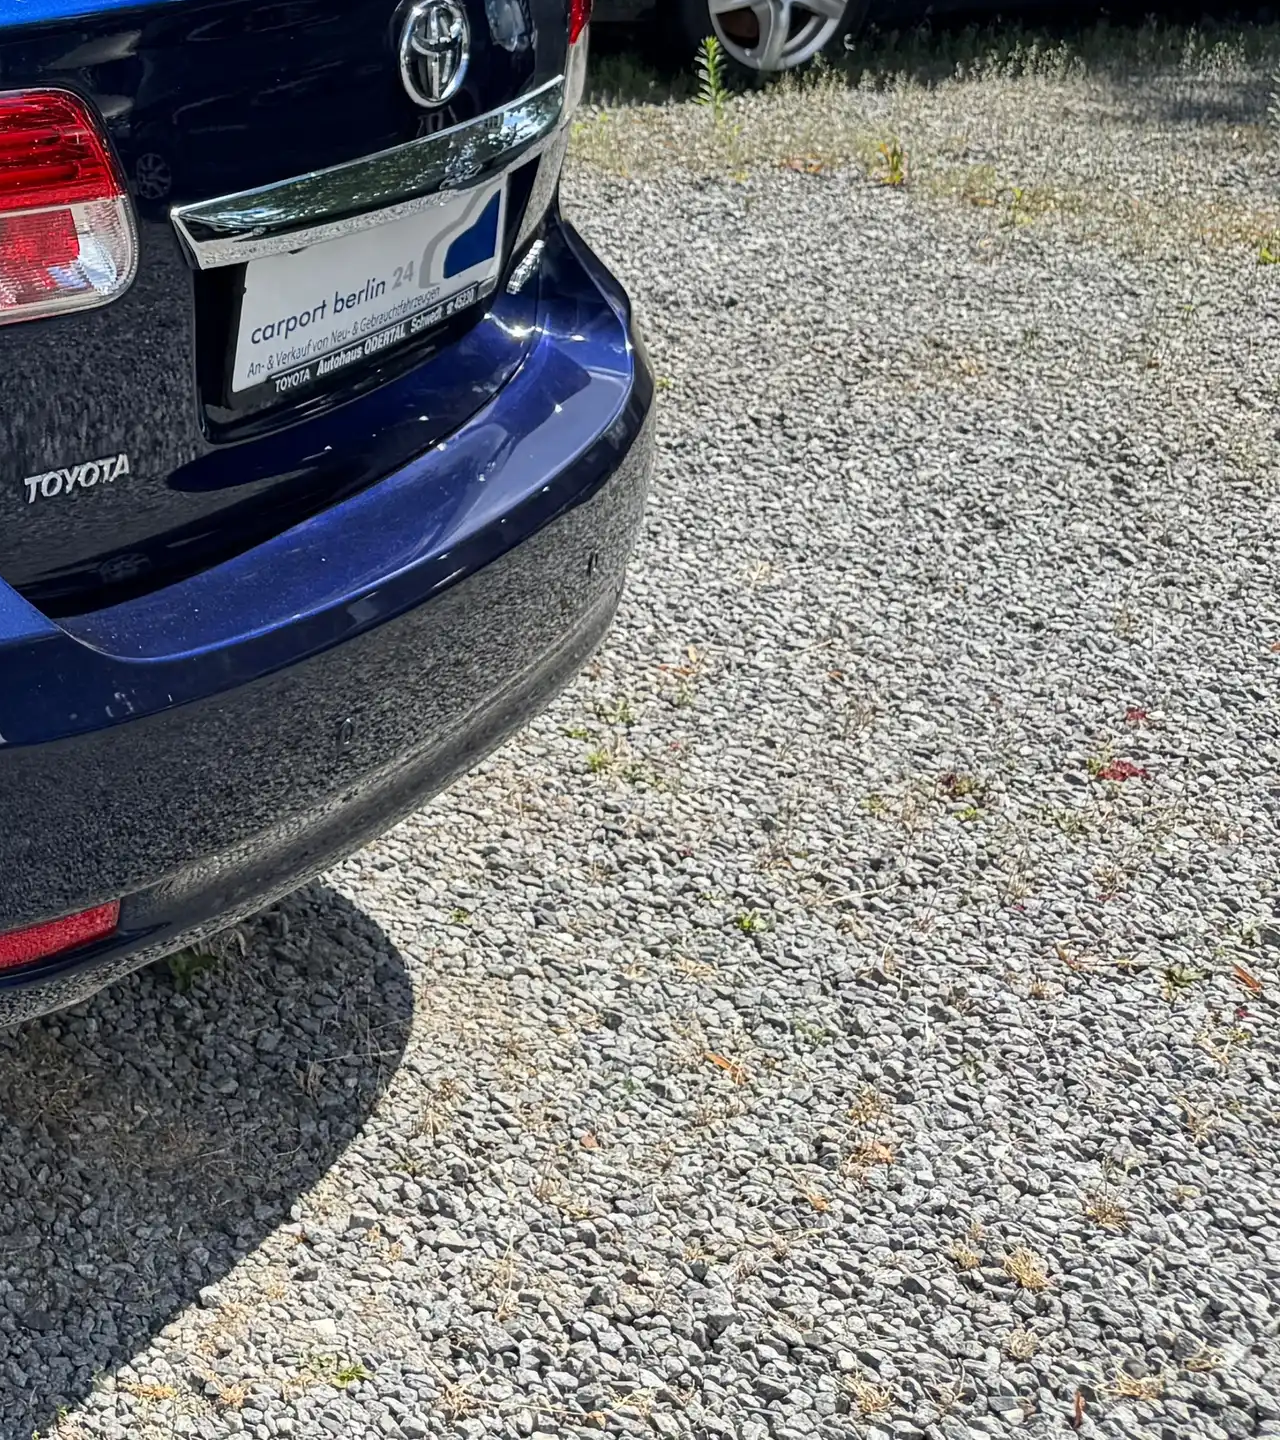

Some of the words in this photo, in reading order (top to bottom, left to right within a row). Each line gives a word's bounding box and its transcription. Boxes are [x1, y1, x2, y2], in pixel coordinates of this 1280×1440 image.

[250, 299, 328, 345] carport
[333, 277, 387, 316] berlin
[391, 260, 415, 291] 24
[246, 361, 266, 379] An-
[266, 354, 275, 371] &
[275, 339, 313, 368] Verkauf
[312, 336, 329, 352] von
[330, 329, 351, 346] Neu-
[351, 320, 359, 336] &
[274, 368, 311, 394] TOYOTA
[316, 345, 364, 377] Autohaus
[363, 324, 407, 356] ODERTAL
[24, 453, 130, 504] TOYOTA
